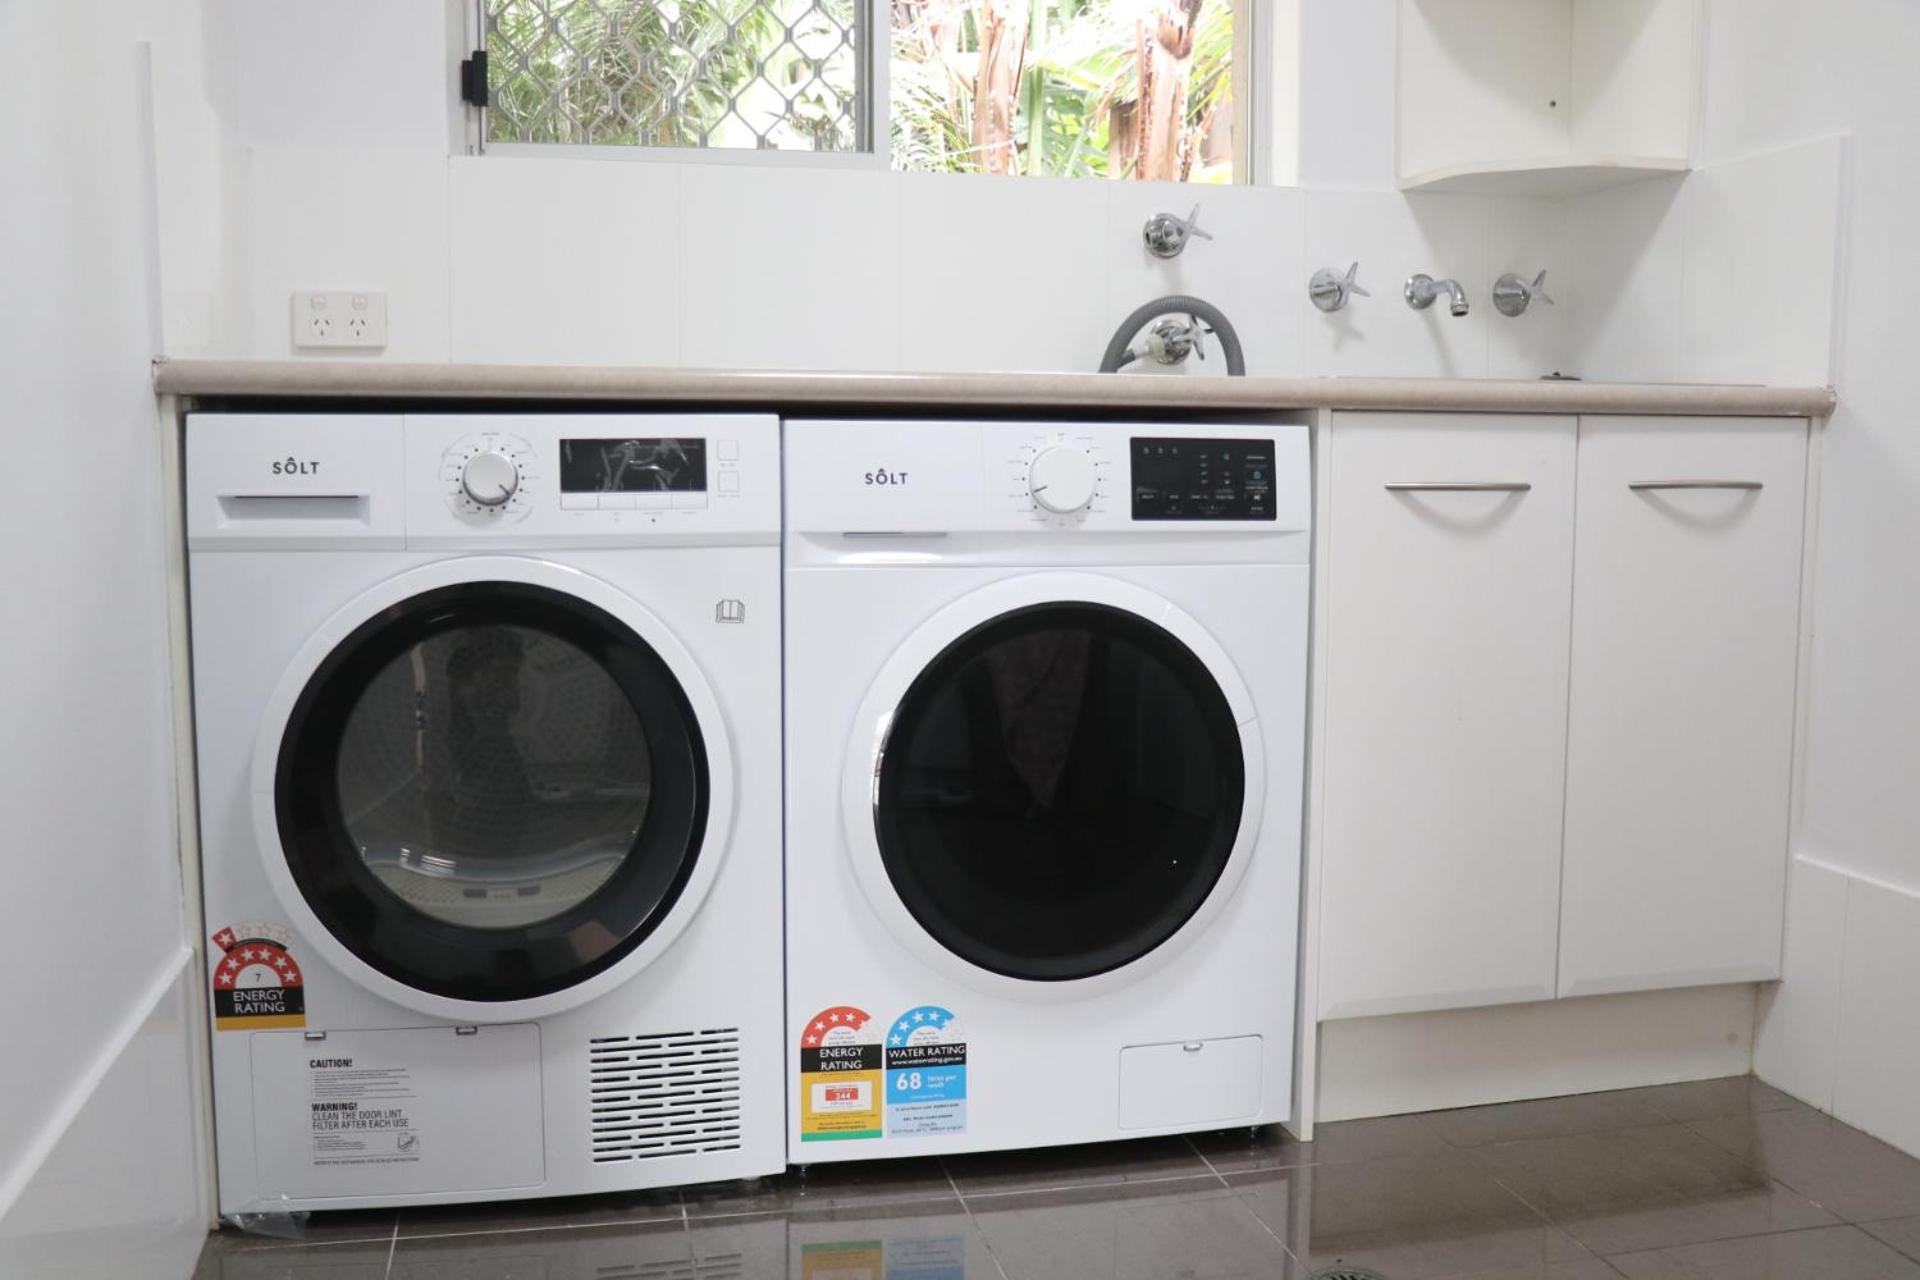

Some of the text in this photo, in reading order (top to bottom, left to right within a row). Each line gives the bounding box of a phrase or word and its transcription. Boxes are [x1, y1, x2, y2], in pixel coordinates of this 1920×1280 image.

[255, 973, 262, 982] 7
[233, 989, 285, 1002] ENERGY
[234, 1001, 286, 1014] RATING
[820, 1047, 864, 1058] ENERGY
[888, 1045, 966, 1058] WATER RATING
[310, 1058, 353, 1068] CAUTION!
[821, 1060, 863, 1071] RATING
[896, 1072, 922, 1090] 68
[312, 1102, 358, 1111] WARNING!
[312, 1108, 402, 1120] CLEAN THE DOOR LINT
[312, 1118, 409, 1130] FILTER AFTER EACH USE
